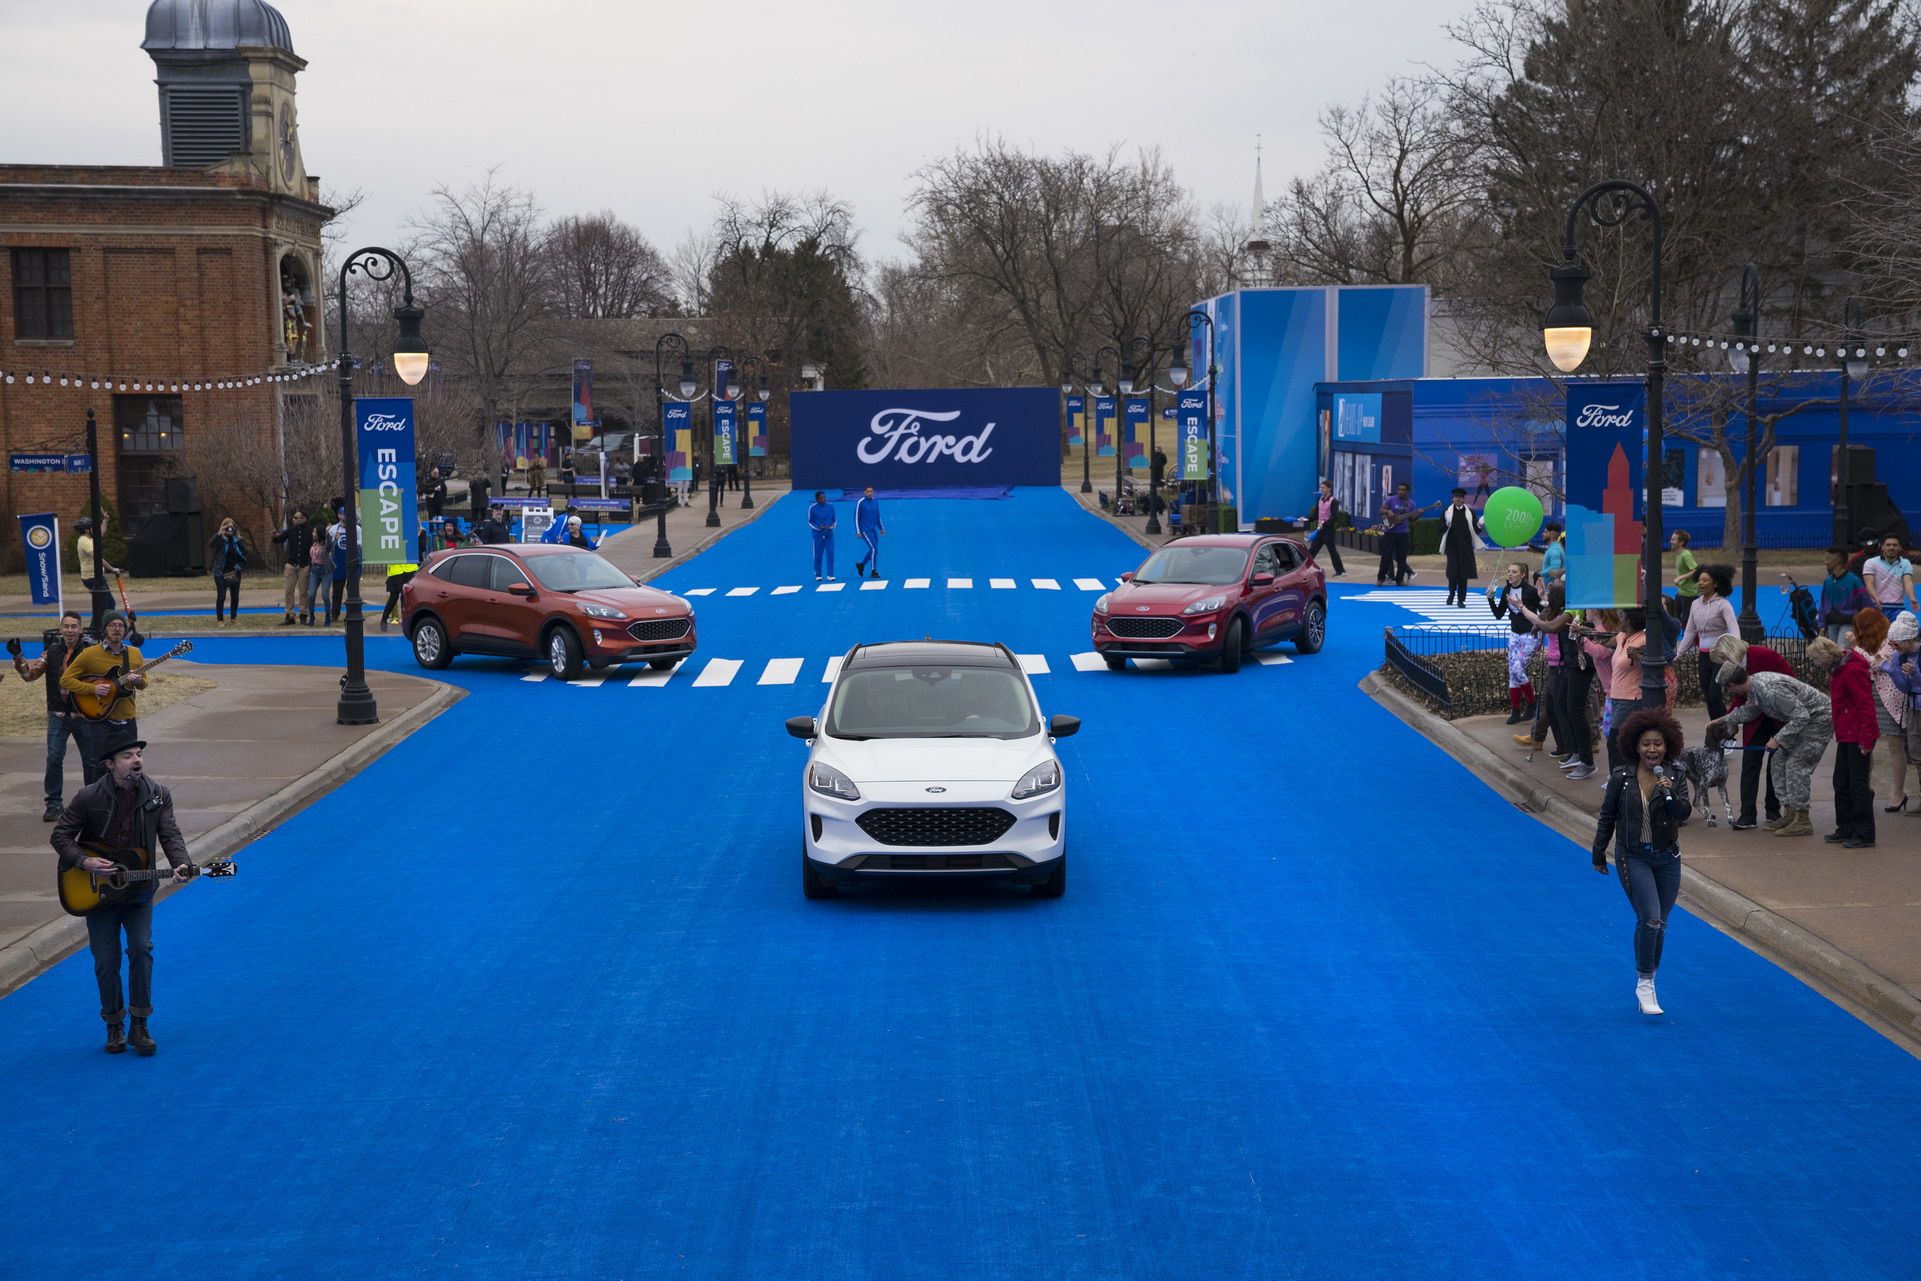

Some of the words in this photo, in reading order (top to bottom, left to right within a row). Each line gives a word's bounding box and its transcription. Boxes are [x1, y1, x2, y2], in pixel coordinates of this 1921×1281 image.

[716, 406, 733, 414] Ford
[749, 406, 764, 414] Ford
[1098, 402, 1113, 410] Ford
[1127, 404, 1146, 413] Ford
[1181, 398, 1204, 409] Ford
[364, 413, 406, 431] Ford
[667, 409, 688, 419] Ford
[1576, 404, 1634, 428] Ford
[721, 419, 731, 459] ESCAPE
[857, 408, 996, 464] Ford
[1187, 417, 1198, 473] ESCAPE
[377, 448, 400, 550] ESCAPE
[38, 552, 50, 598] Snow/Sand
